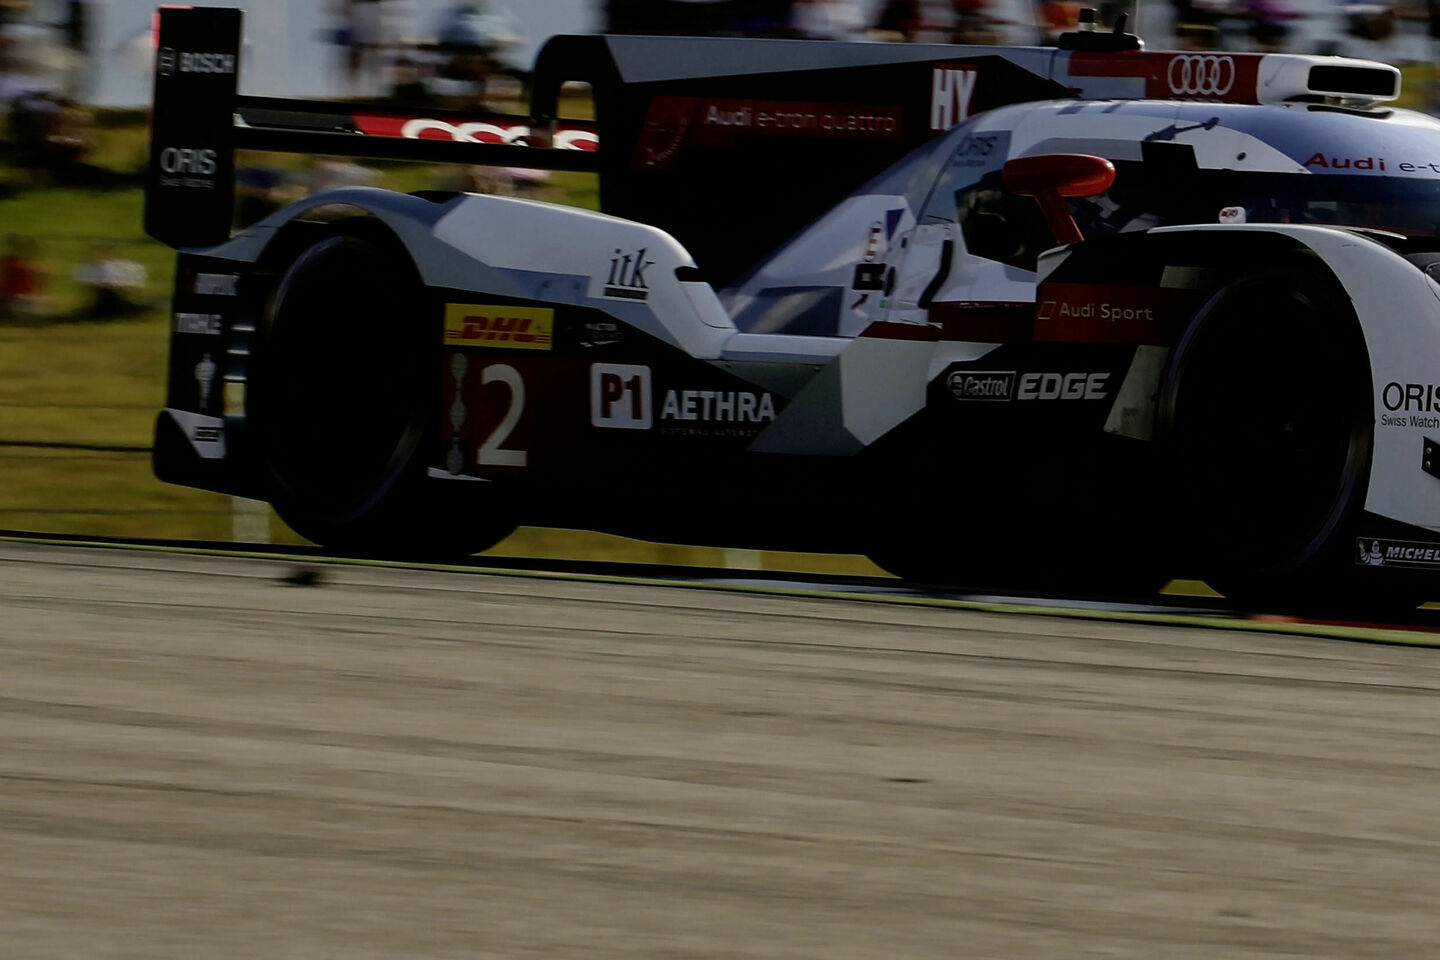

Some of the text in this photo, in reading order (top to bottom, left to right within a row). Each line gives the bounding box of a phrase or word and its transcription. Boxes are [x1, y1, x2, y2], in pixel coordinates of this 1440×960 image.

[929, 68, 978, 131] HY
[704, 104, 752, 126] Audi
[159, 146, 218, 175] ORIS
[1303, 152, 1385, 172] Audi
[605, 248, 655, 289] itk
[1059, 302, 1154, 322] Audi Sport
[462, 316, 538, 343] DHL
[601, 372, 642, 421] P1
[963, 372, 1111, 400] Castrol EDGE
[476, 363, 528, 467] 2
[659, 390, 777, 422] AETHRA
[1381, 414, 1407, 427] Swiss
